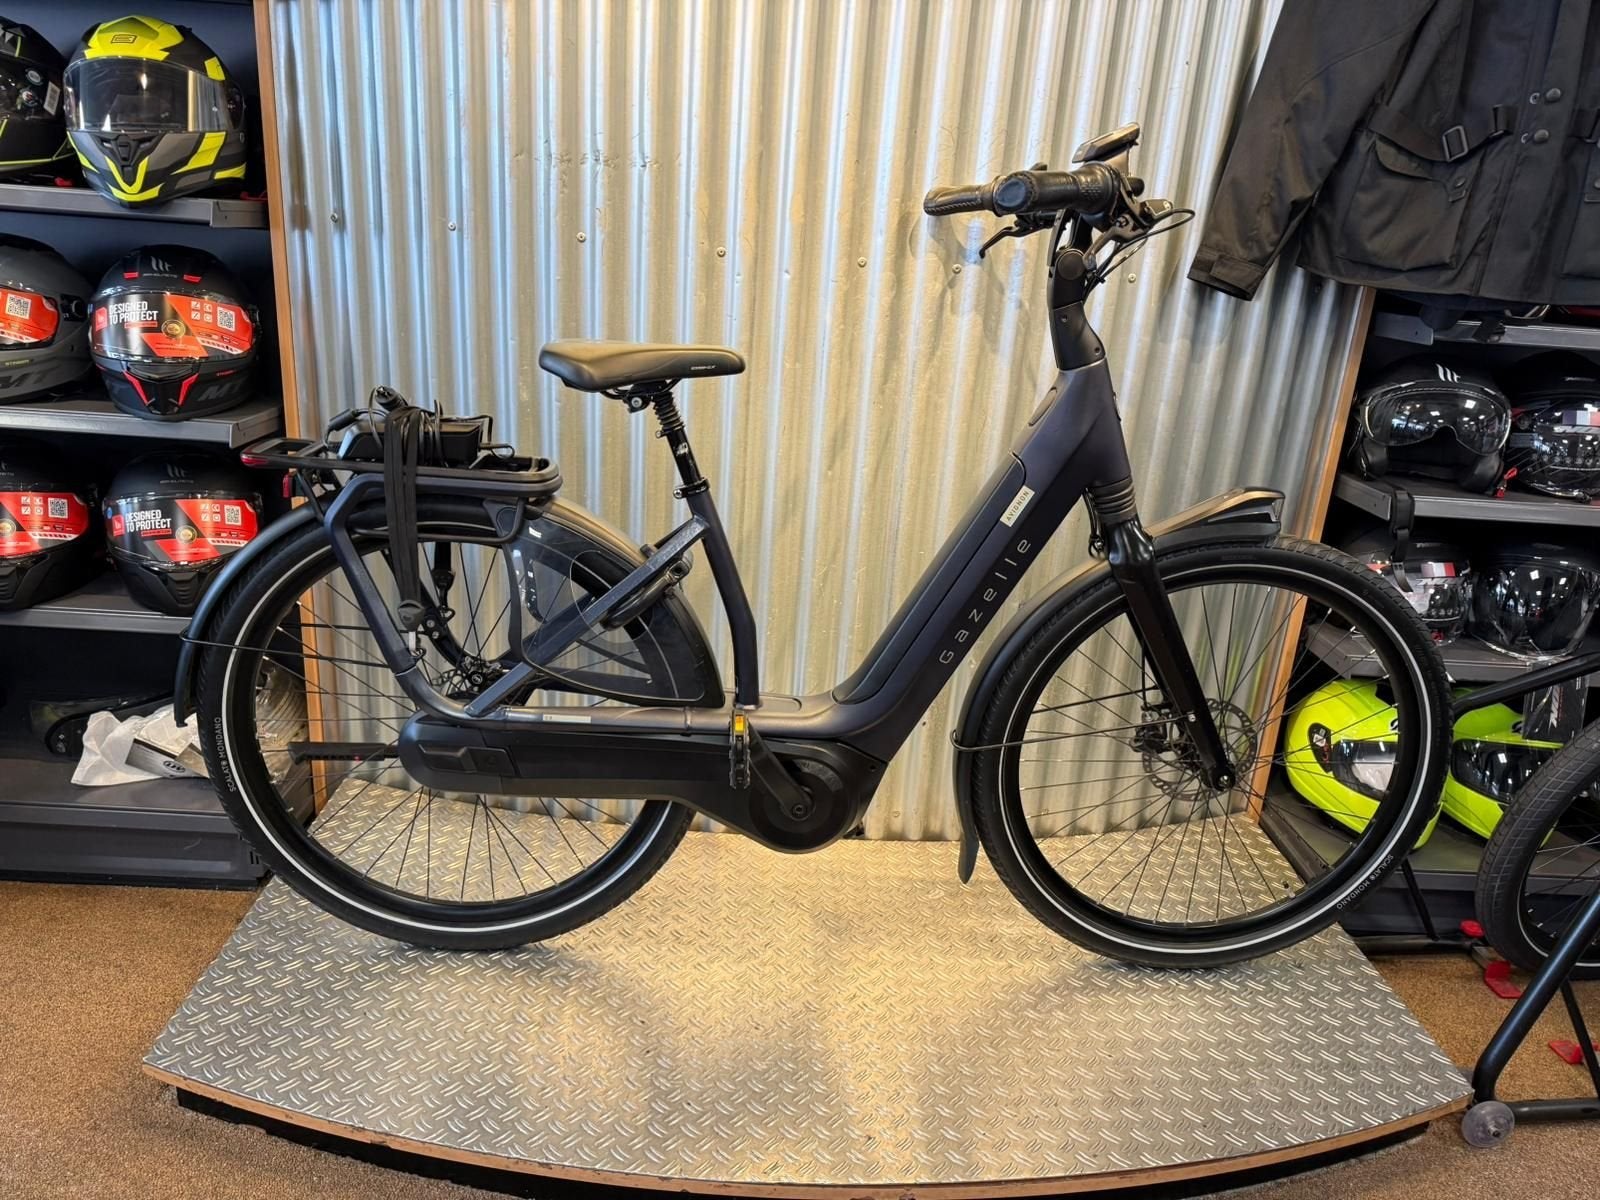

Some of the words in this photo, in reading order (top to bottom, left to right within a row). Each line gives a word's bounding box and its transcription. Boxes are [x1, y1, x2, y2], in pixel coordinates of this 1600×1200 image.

[109, 301, 148, 314] DESIGNED
[109, 313, 118, 325] TO
[120, 311, 158, 323] PROTECT
[126, 510, 162, 523] DESIGNED
[1006, 490, 1030, 521] AVIGNON
[126, 522, 135, 533] TO
[136, 518, 171, 531] PROTECT
[938, 538, 1032, 665] Gazelle
[214, 717, 225, 758] MONDANO
[1336, 880, 1371, 910] MONDANO
